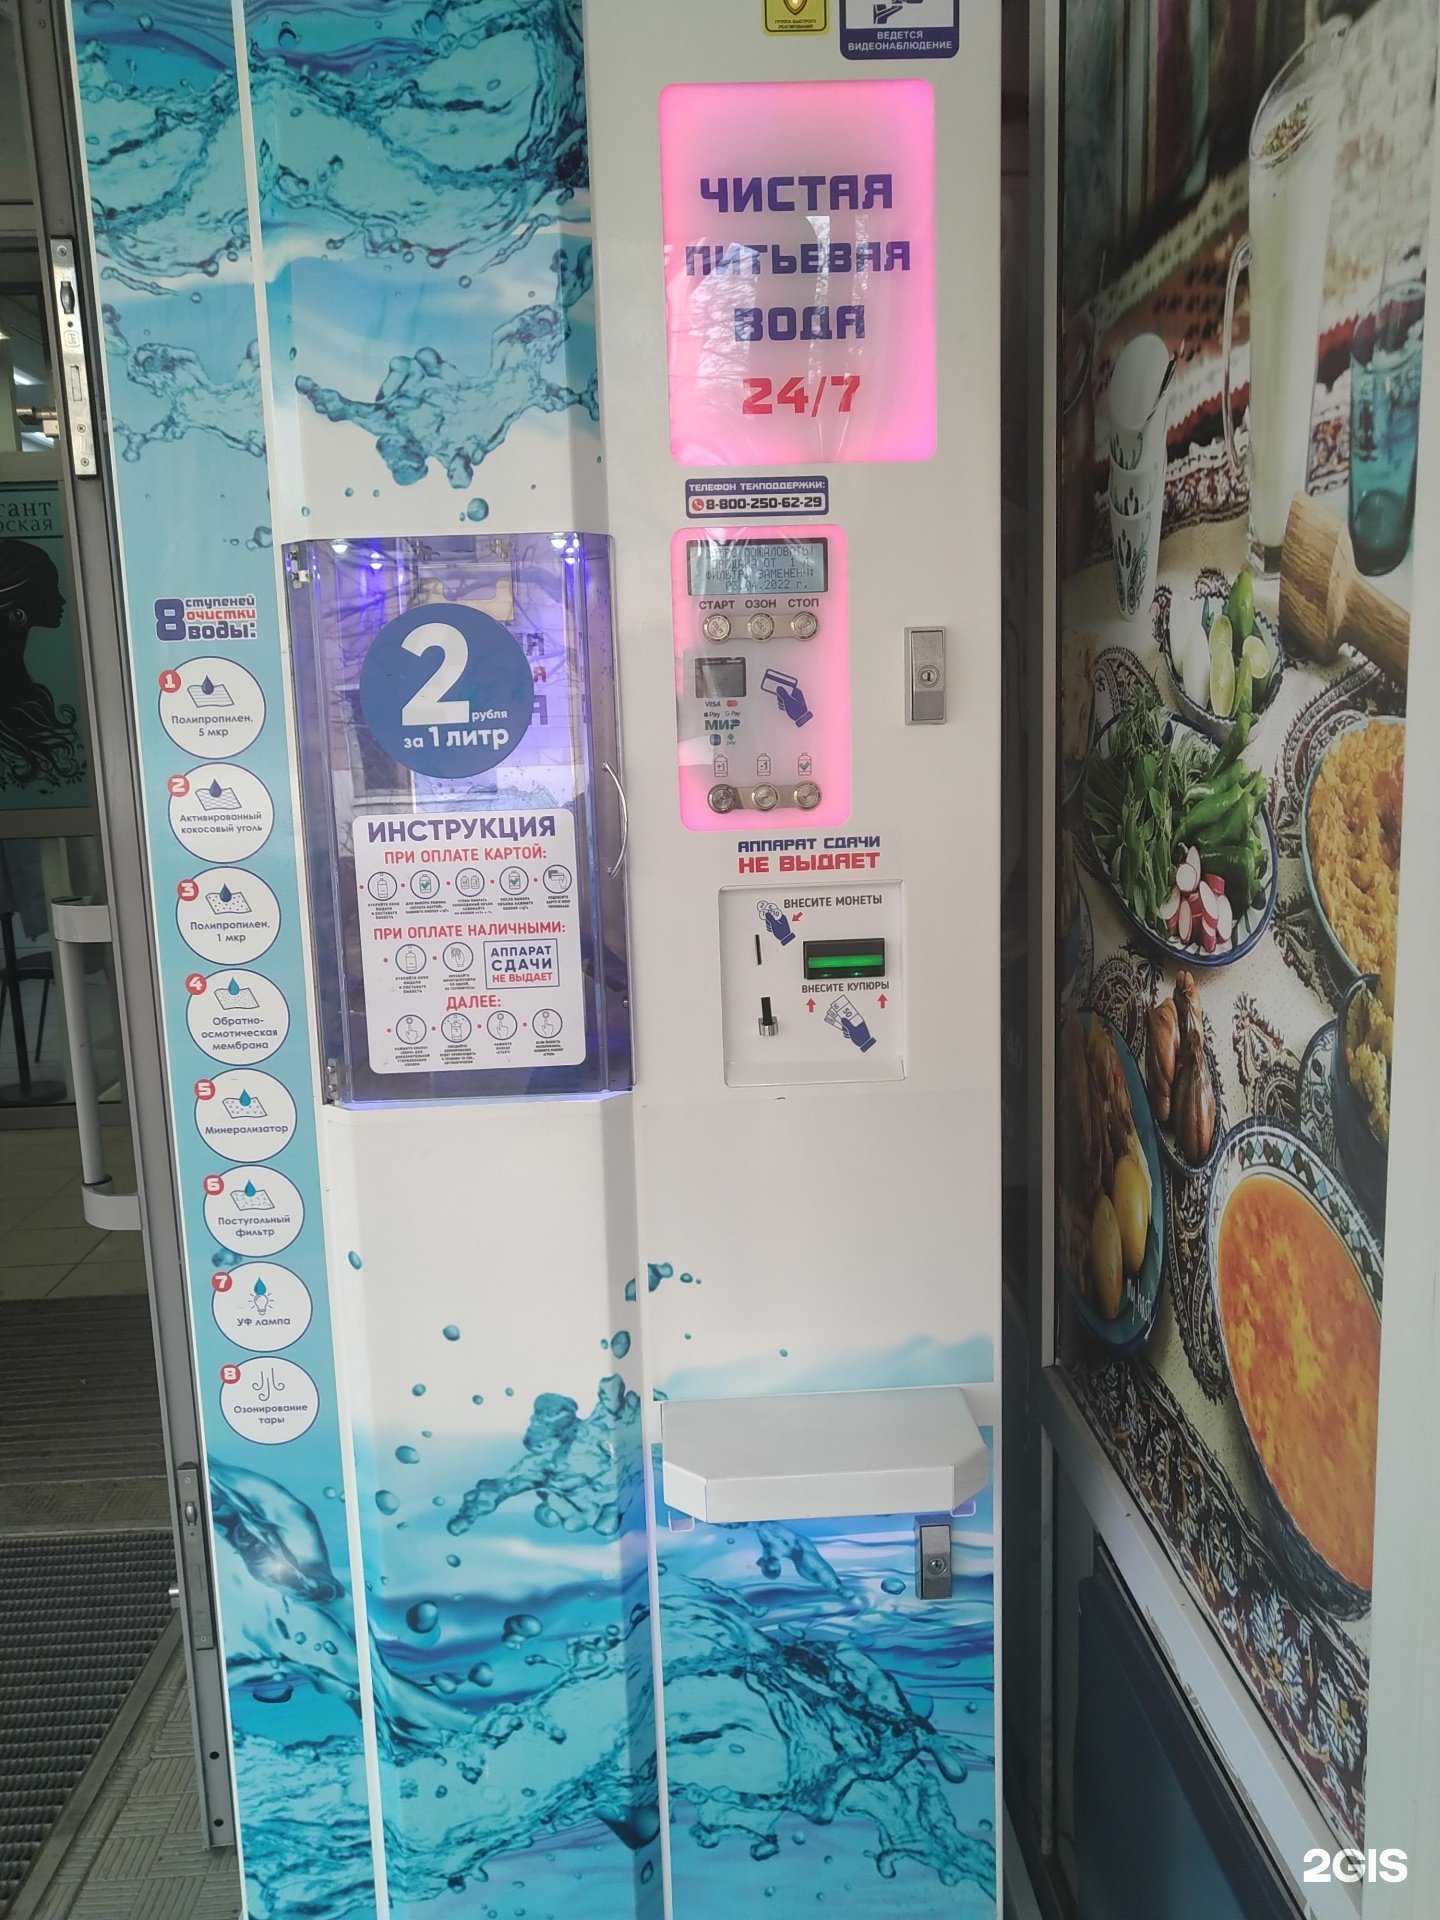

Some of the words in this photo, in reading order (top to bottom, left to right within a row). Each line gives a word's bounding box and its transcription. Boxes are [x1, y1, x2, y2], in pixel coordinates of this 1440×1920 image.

[877, 31, 923, 40] ВЕДЕТСЯ
[848, 41, 952, 52] ВИДЕОНАБЛЮДЕНИЕ
[700, 174, 892, 213] ЧИСТАЯ
[686, 241, 910, 276] ПИТЬЕВАЯ
[734, 305, 865, 342] ВОДА
[742, 376, 860, 417] 24/7
[689, 484, 736, 492] ТЕЛЕФОН
[740, 482, 826, 491] ТЕХПОДДЕРЖКИ:
[706, 496, 822, 510] 8-800-250-62-29
[186, 595, 255, 609] ступеней
[699, 600, 736, 610] СТАРТ
[744, 600, 776, 608] ОЗОН
[788, 598, 820, 608] СТОП
[155, 598, 186, 641] 8
[186, 610, 256, 620] очистки
[188, 621, 256, 639] воды:
[165, 674, 176, 688] 1
[401, 622, 470, 726] 2
[472, 710, 508, 722] рубля
[704, 719, 740, 730] МИР
[198, 728, 204, 736] 5
[208, 728, 229, 738] мкр
[404, 737, 424, 748] за
[428, 726, 440, 747] 1
[446, 728, 510, 750] литр
[171, 777, 186, 793] 2
[180, 811, 262, 823] Активированный
[180, 825, 234, 834] кокосовый
[236, 824, 262, 834] уголь
[368, 816, 556, 842] ИНСТРУКЦИЯ
[738, 838, 816, 852] АППАРАТ
[824, 836, 880, 850] СДАЧИ
[384, 850, 415, 864] ПРИ
[420, 848, 479, 863] ОПЛАТЕ
[484, 844, 546, 860] КАРТОЙ:
[738, 857, 769, 874] НЕ
[780, 852, 880, 872] ВЫДАЕТ
[181, 882, 194, 898] 3
[784, 896, 832, 908] ВНЕСИТЕ
[836, 894, 882, 906] МОНЕТЫ
[373, 927, 402, 940] ПРИ
[408, 925, 462, 938] ОПЛАТЕ
[468, 922, 566, 937] НАЛИЧНЫМИ:
[217, 934, 221, 942] 1
[225, 934, 246, 943] мкр
[490, 946, 552, 957] АППАРАТ
[492, 958, 552, 972] СДАЧИ
[190, 976, 202, 990] 4
[492, 974, 508, 982] НЕ
[509, 972, 552, 982] ВЫДАЕТ
[802, 983, 844, 994] ВНЕСИТЕ
[848, 980, 890, 992] КУПЮРЫ
[446, 994, 502, 1011] ДАЛЕЕ:
[212, 1016, 264, 1026] Обратно-
[201, 1028, 278, 1039] осмотическая
[212, 1040, 268, 1051] мембрана
[198, 1082, 212, 1097] 5
[205, 1124, 288, 1136] Минерализатор
[207, 1178, 220, 1192] 6
[218, 1214, 290, 1226] Постугольный
[236, 1228, 275, 1238] фильтр
[215, 1275, 228, 1290] 7
[237, 1318, 252, 1326] УФ
[255, 1318, 290, 1326] лампа
[224, 1367, 236, 1382] 8
[234, 1404, 308, 1415] Озонирование
[258, 1416, 284, 1426] тары
